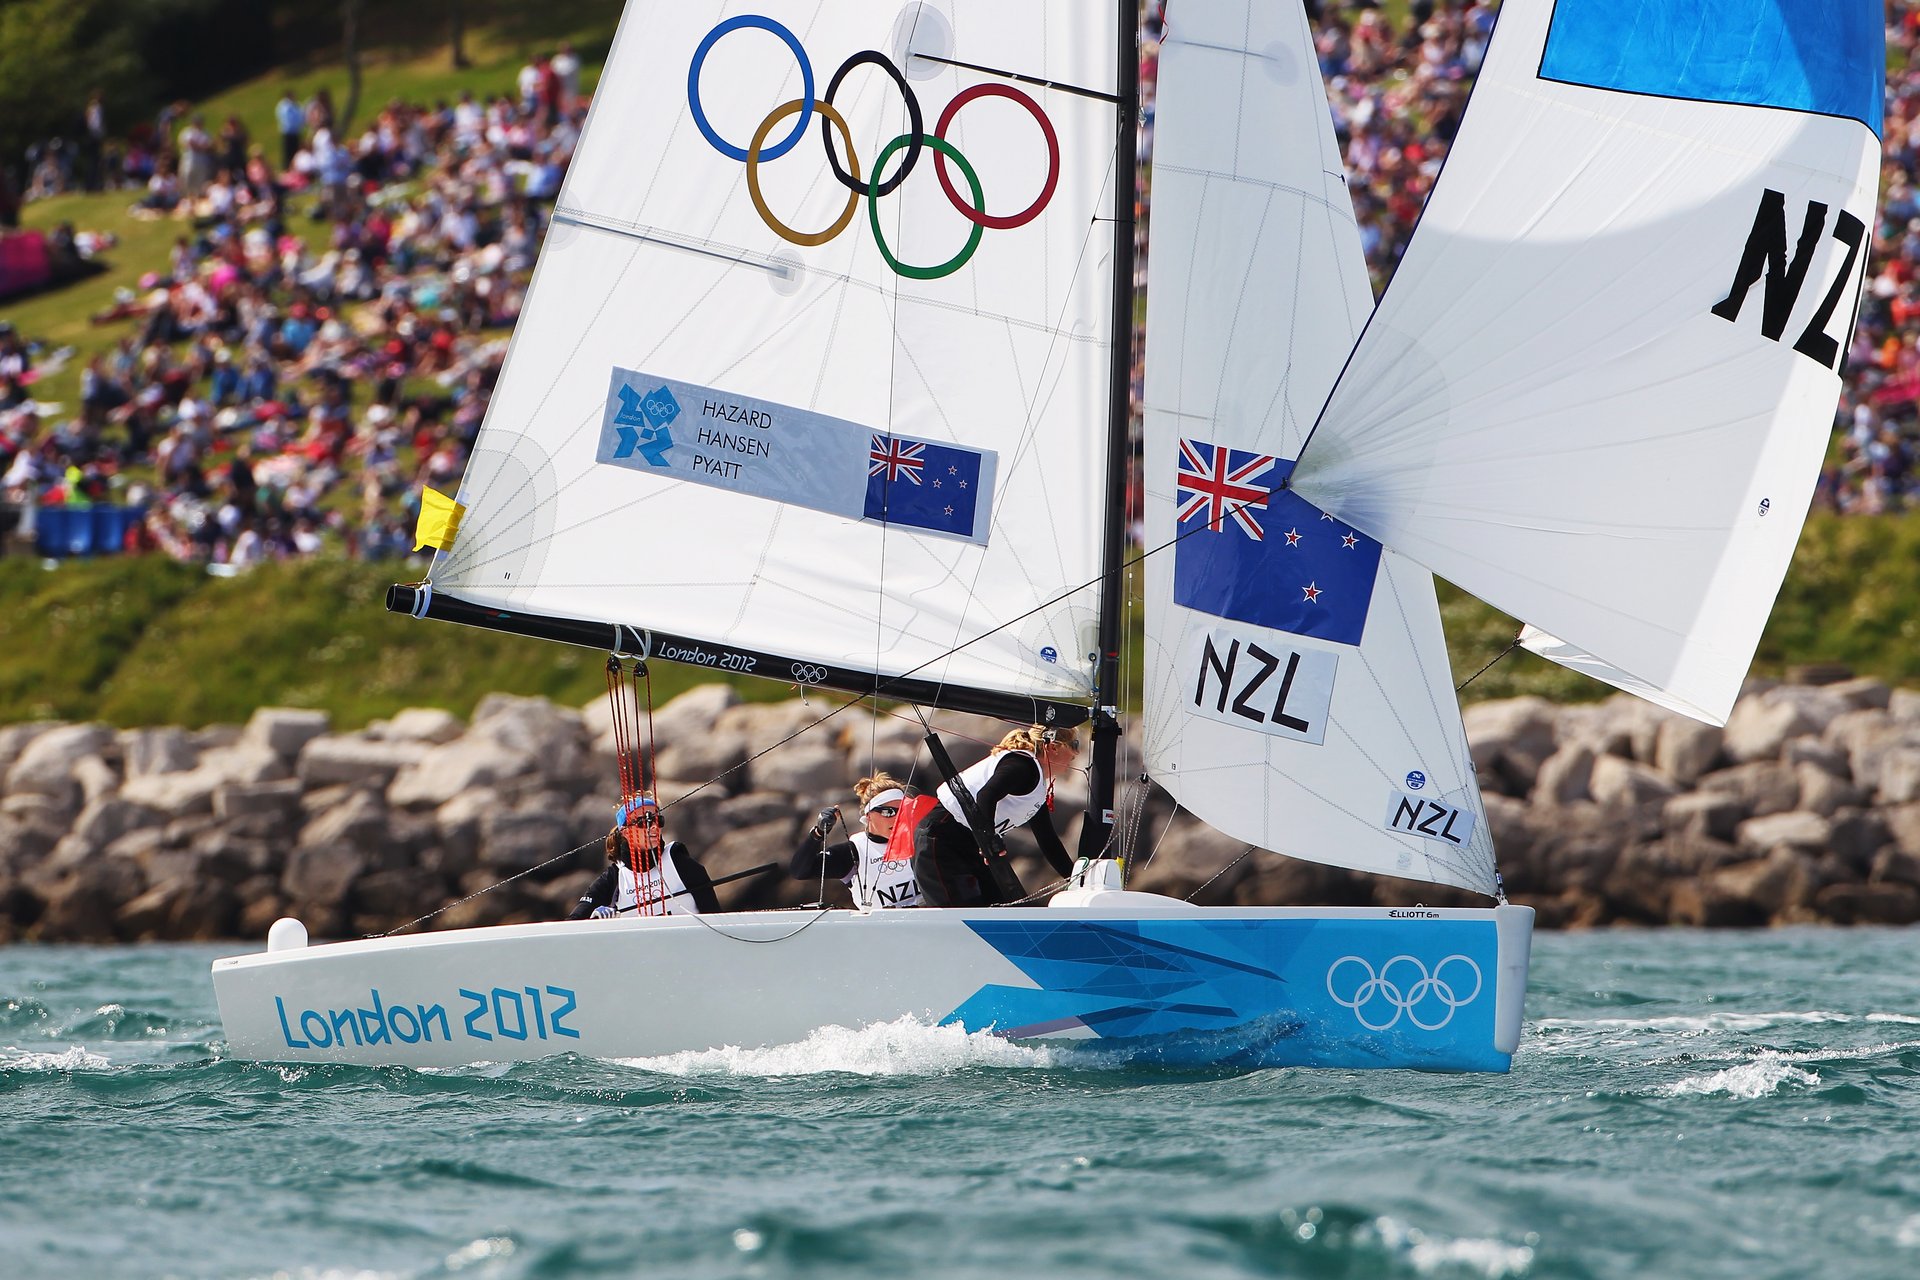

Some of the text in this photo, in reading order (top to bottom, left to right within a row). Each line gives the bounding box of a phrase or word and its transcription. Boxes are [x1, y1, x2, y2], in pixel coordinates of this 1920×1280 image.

[1710, 187, 1871, 384] NZ
[702, 399, 772, 429] HAZARD
[697, 427, 770, 459] HANSEN
[692, 454, 743, 480] PYATT
[658, 641, 757, 672] London 2012
[1194, 632, 1309, 734] NZL
[1391, 796, 1462, 844] NZL
[649, 878, 663, 889] 201
[1388, 909, 1425, 918] ELLIOTT
[274, 985, 581, 1049] London 2012
